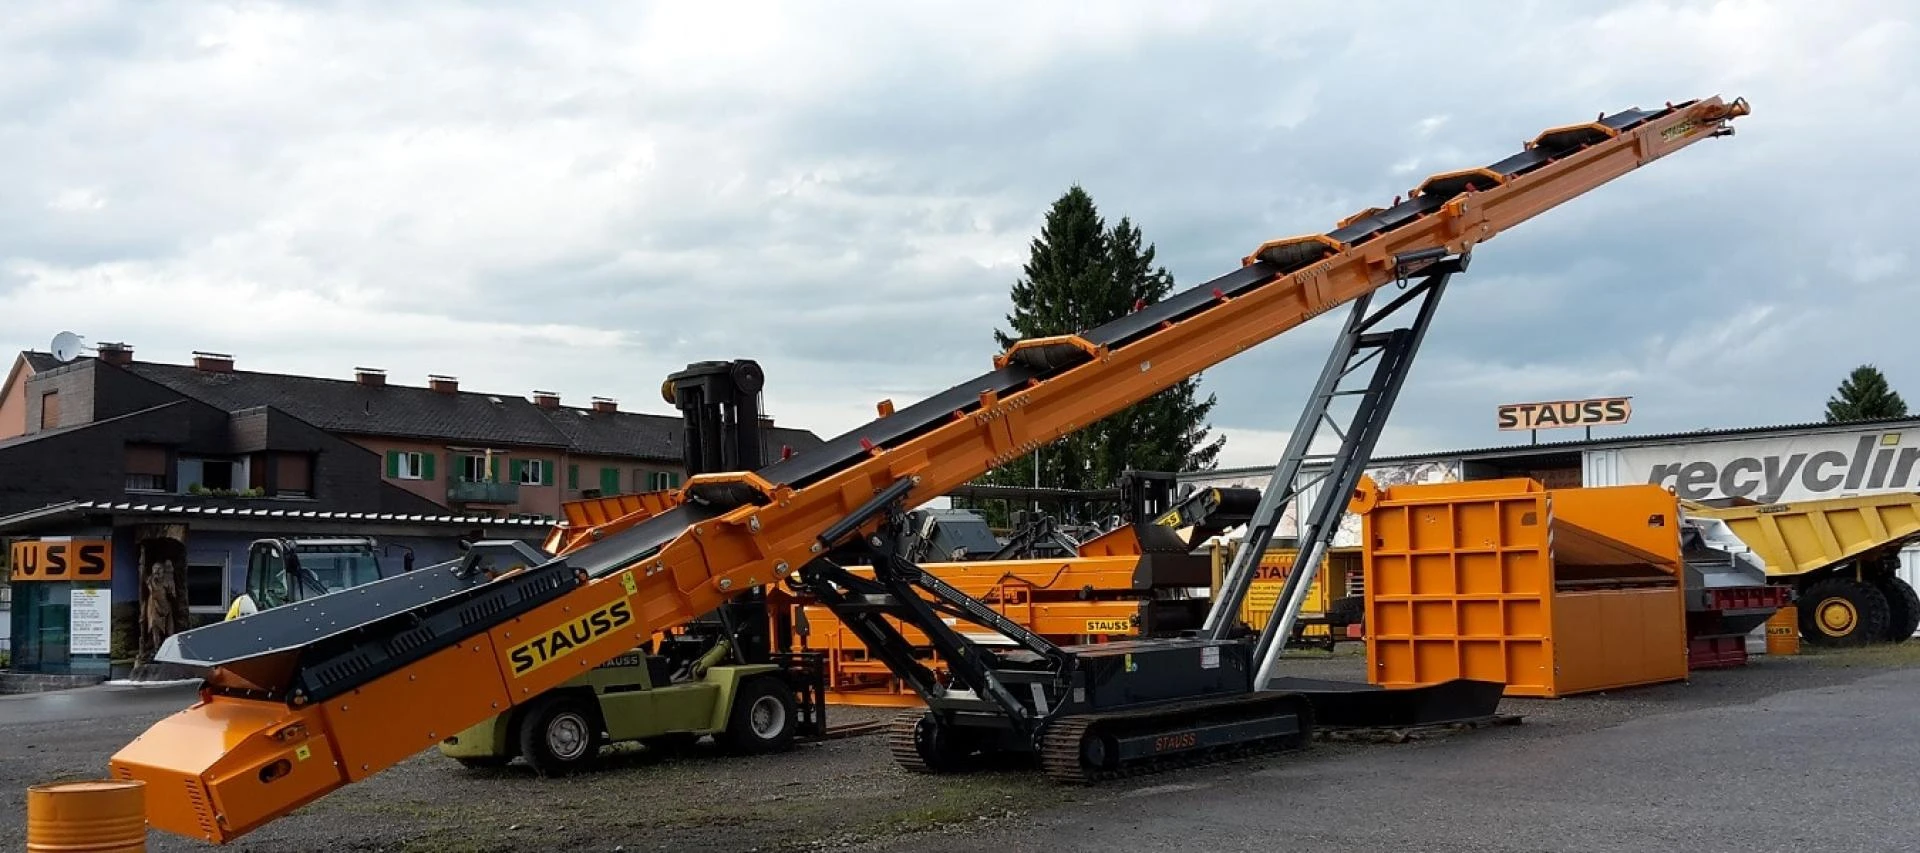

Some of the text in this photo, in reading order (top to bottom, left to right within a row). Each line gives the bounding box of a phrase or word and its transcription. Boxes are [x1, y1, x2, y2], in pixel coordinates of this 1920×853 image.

[1498, 401, 1626, 428] STAUSS
[1648, 435, 1920, 504] recyclin
[511, 601, 631, 673] STAUSS
[1087, 621, 1129, 631] STAUSS
[1155, 733, 1196, 751] STAUSS
